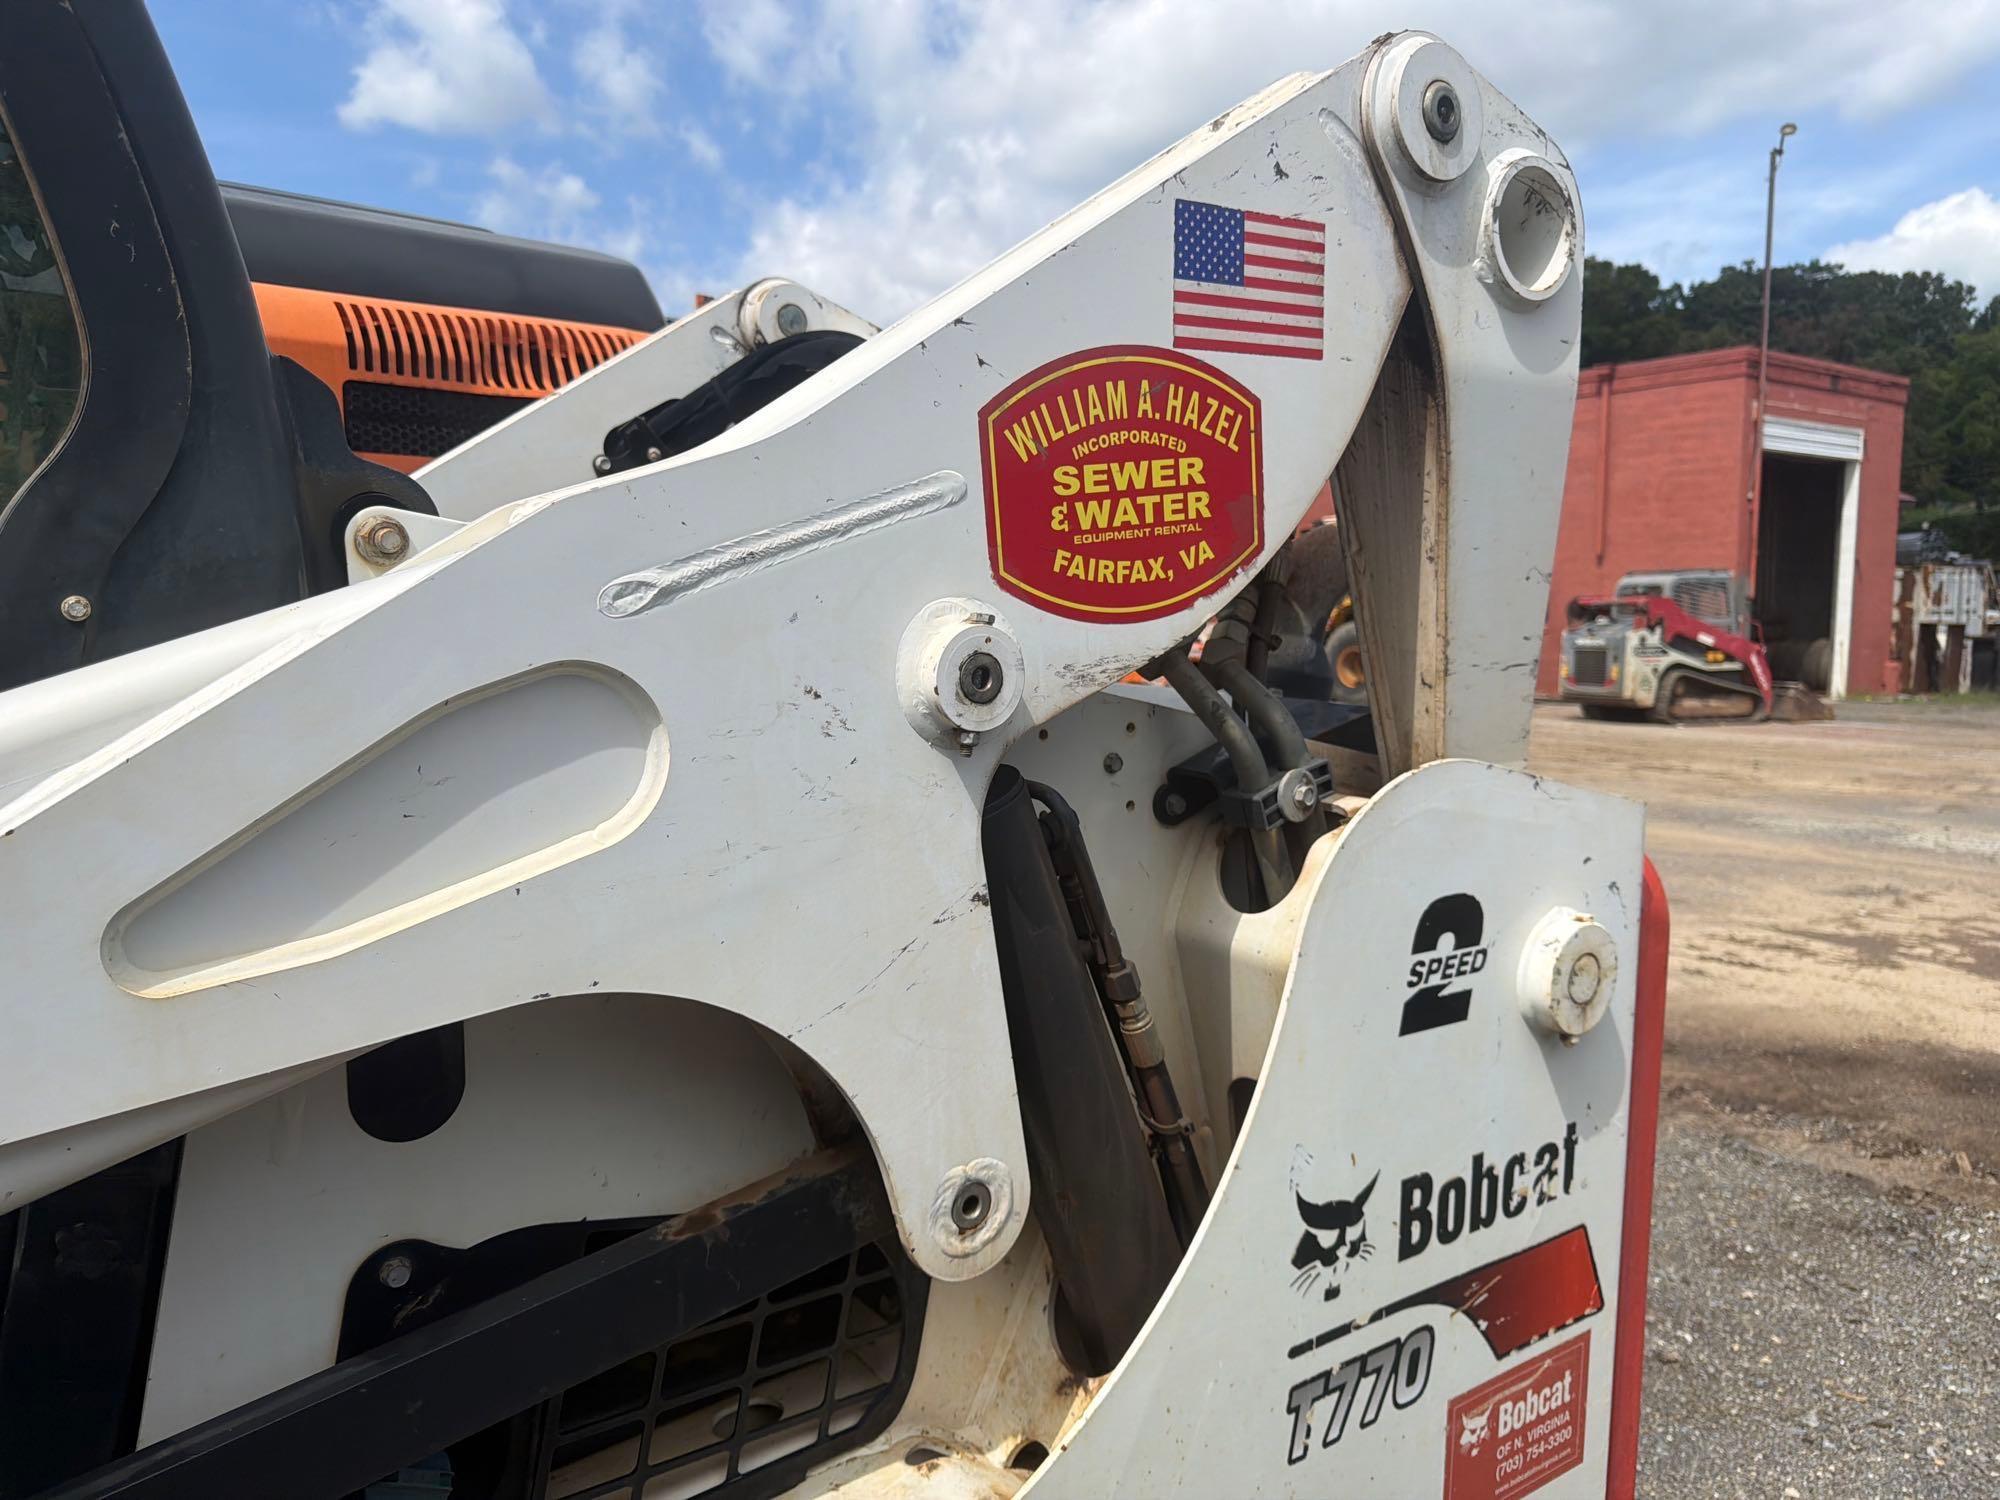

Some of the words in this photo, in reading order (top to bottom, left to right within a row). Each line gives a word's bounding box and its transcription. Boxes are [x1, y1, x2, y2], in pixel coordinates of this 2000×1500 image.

[1004, 380, 1128, 463] WILLIAM
[1137, 379, 1160, 420] A.
[1165, 383, 1243, 452] HAZEL
[1072, 430, 1187, 460] INCORPORATED
[1053, 457, 1206, 496] SEWER
[1051, 501, 1068, 532] &
[1075, 491, 1212, 530] WATER
[1073, 528, 1151, 544] EQUIPMENT
[1154, 523, 1202, 536] RENTAL
[1053, 549, 1174, 583] FAIRFAX,
[1179, 540, 1215, 570] VA
[1399, 893, 1484, 1037] 2
[1407, 948, 1488, 988] SPEED
[1398, 1122, 1578, 1263] Bobcat
[1286, 1324, 1435, 1465] T770
[1498, 1370, 1572, 1438] Bobcat
[1495, 1452, 1523, 1482] (703)
[1526, 1425, 1573, 1462] 754-3300
[1496, 1441, 1512, 1459] OF
[1513, 1436, 1524, 1451] N.
[1526, 1410, 1570, 1442] VIRGINIA
